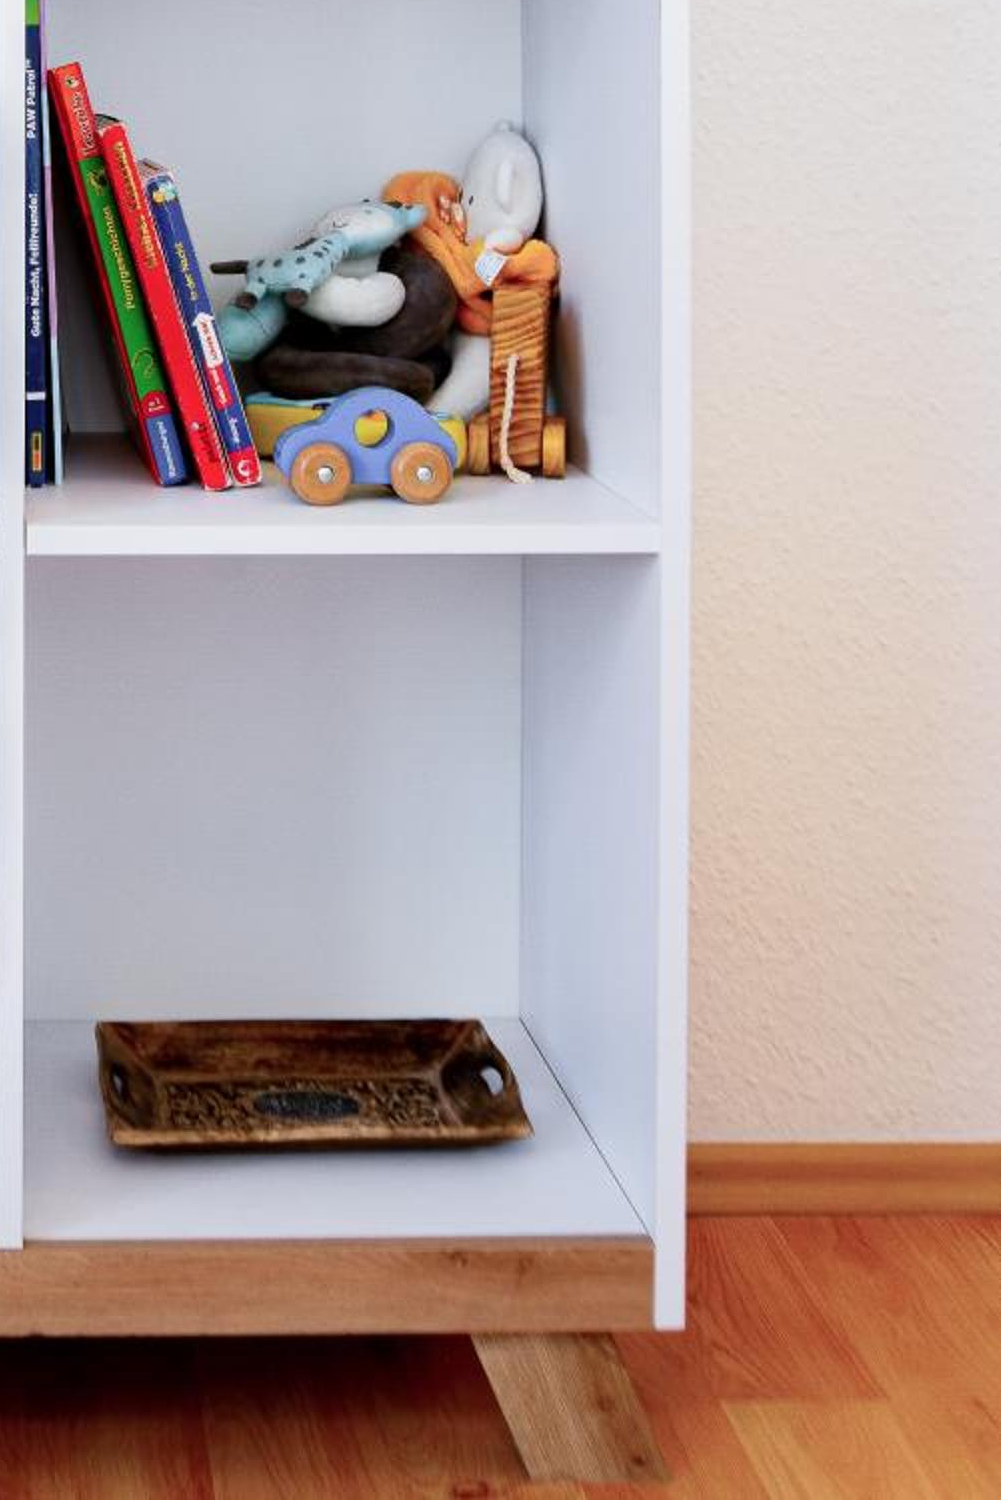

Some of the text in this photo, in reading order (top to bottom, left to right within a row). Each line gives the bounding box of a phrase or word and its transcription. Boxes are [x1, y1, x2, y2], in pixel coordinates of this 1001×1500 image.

[26, 108, 36, 139] PAW
[28, 193, 39, 265] Fellfreunde!
[30, 309, 41, 338] Gute
